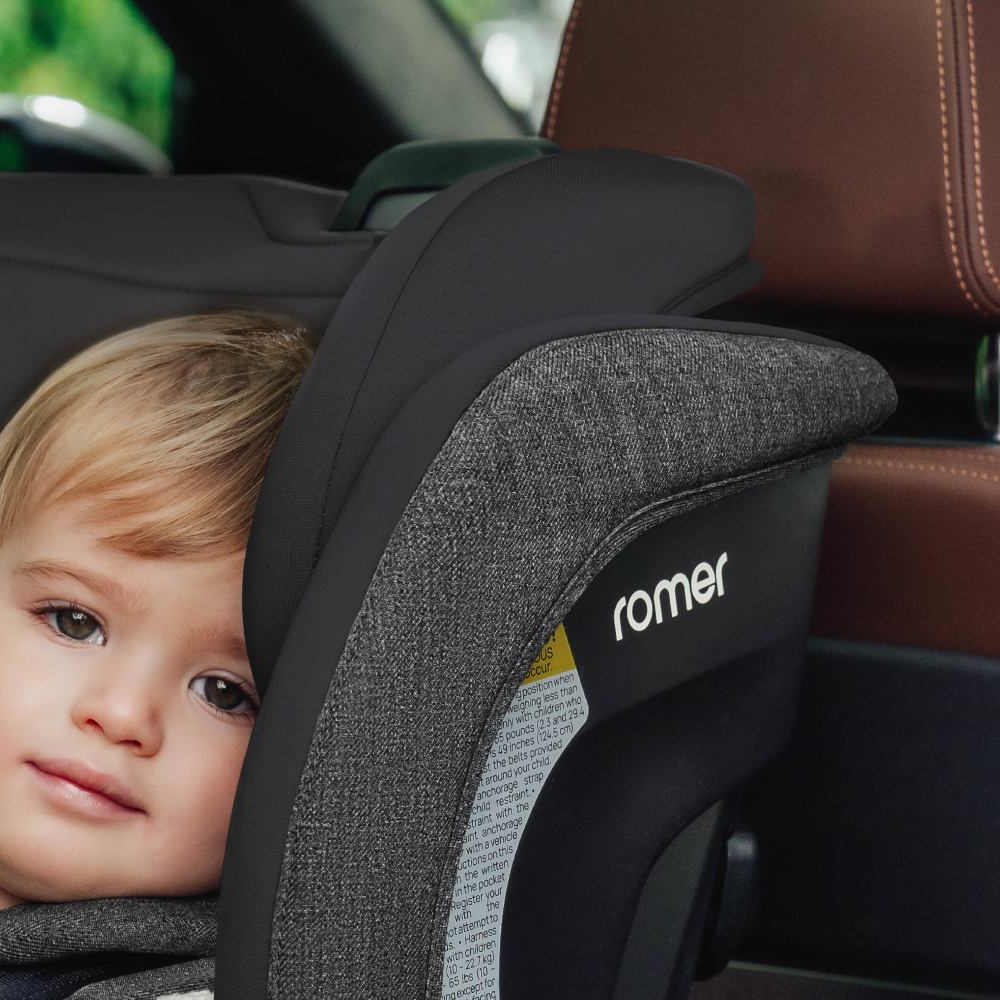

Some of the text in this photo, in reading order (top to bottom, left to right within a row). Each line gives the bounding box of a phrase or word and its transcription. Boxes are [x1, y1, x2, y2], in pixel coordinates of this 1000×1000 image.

[614, 552, 727, 642] romer
[522, 681, 553, 697] position
[554, 673, 574, 687] when
[508, 685, 577, 714] weighing less than
[516, 696, 582, 724] with children who
[506, 707, 584, 743] pounds (2.3 and 29.4
[498, 722, 574, 754] 49 inches (124.5 cm)
[493, 740, 562, 770] the belts provided
[486, 769, 512, 785] around
[514, 764, 530, 778] your
[532, 756, 551, 770] child.
[477, 781, 518, 800] anchorage
[524, 772, 543, 785] strap
[472, 802, 490, 815] child
[496, 802, 529, 819] with the
[482, 817, 523, 837] anchorage
[466, 842, 483, 855] with
[491, 831, 518, 847] vehicle
[488, 845, 513, 860] on this
[465, 860, 508, 881] the written
[463, 873, 505, 894] the pocket
[451, 887, 502, 911] Register your
[455, 901, 500, 922] with the
[459, 914, 498, 934] attempt to
[464, 927, 497, 944] Harness
[446, 950, 463, 963] with
[464, 940, 496, 957] children
[446, 951, 495, 978] (10 22.7 kg)
[449, 967, 488, 988] 65 lbs (10
[457, 978, 495, 998] except for
